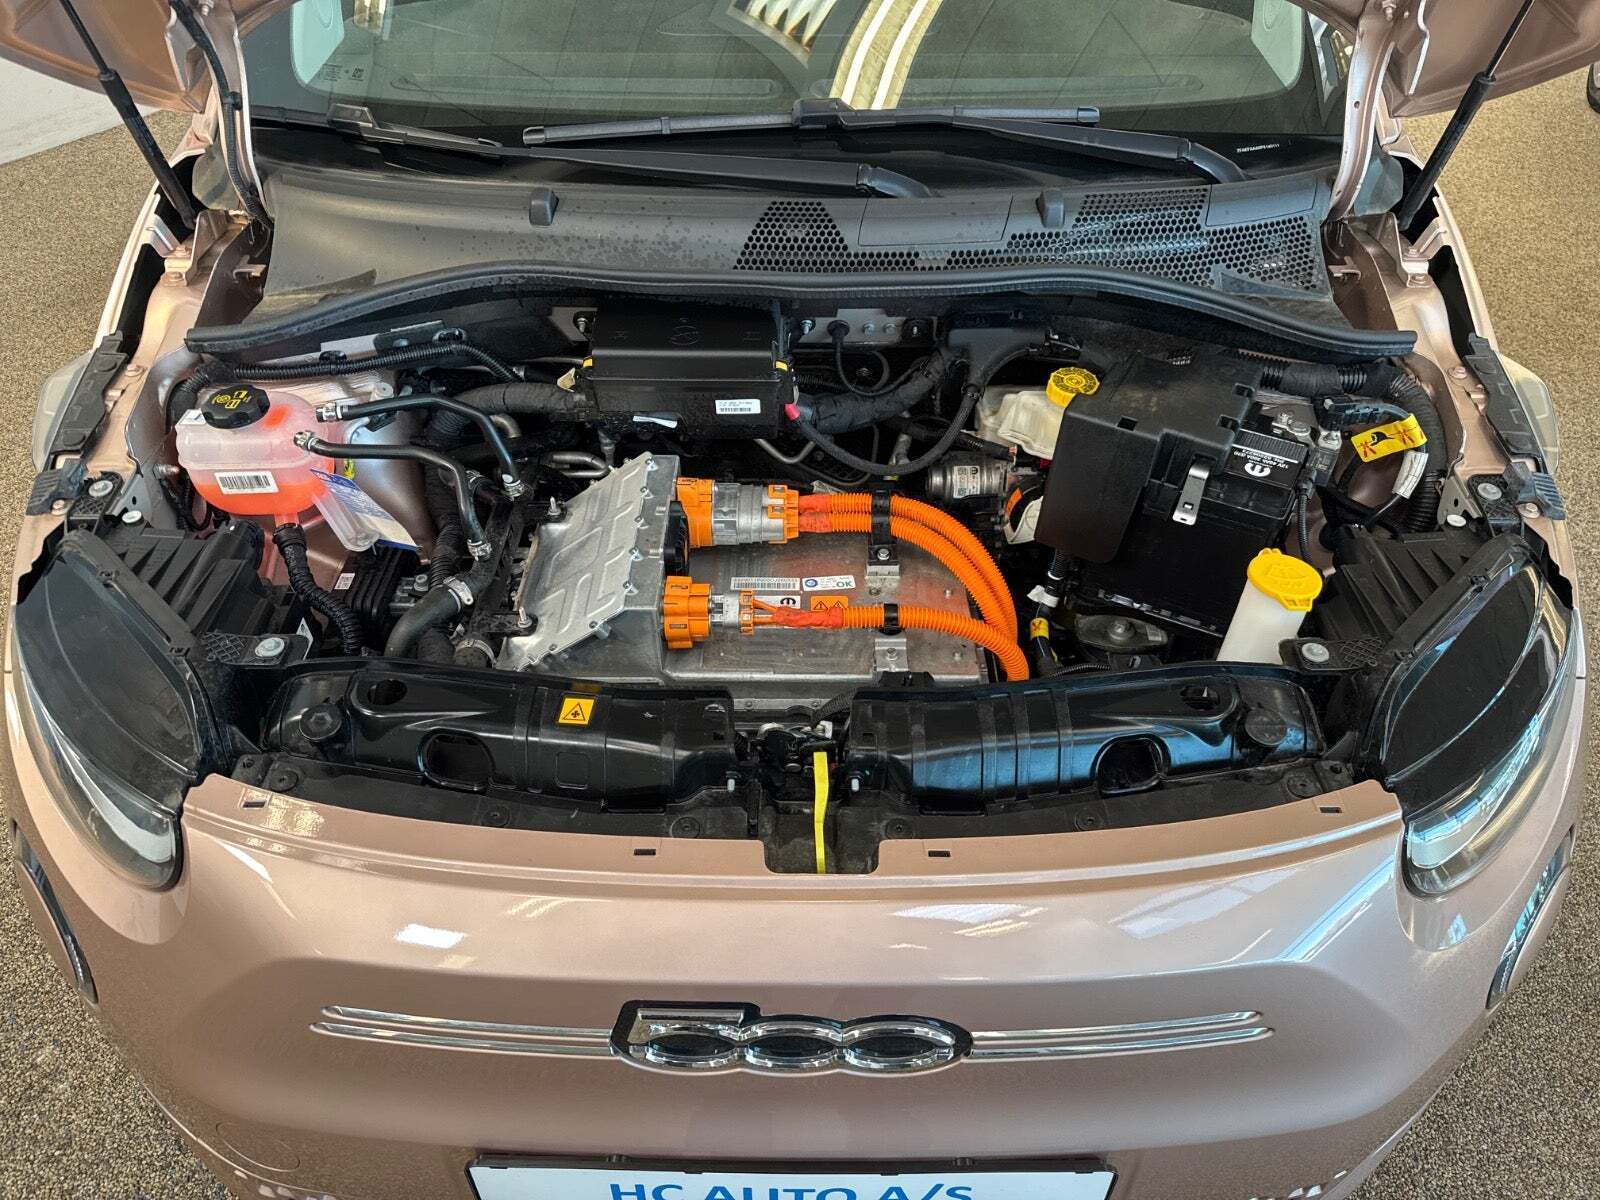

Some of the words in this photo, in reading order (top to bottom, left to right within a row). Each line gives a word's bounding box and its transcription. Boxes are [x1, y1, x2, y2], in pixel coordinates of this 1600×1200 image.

[836, 580, 853, 588] OK
[616, 1002, 970, 1072] 500
[609, 1183, 684, 1200] HC
[703, 1185, 858, 1200] AUTO
[875, 1183, 973, 1200] A/S
